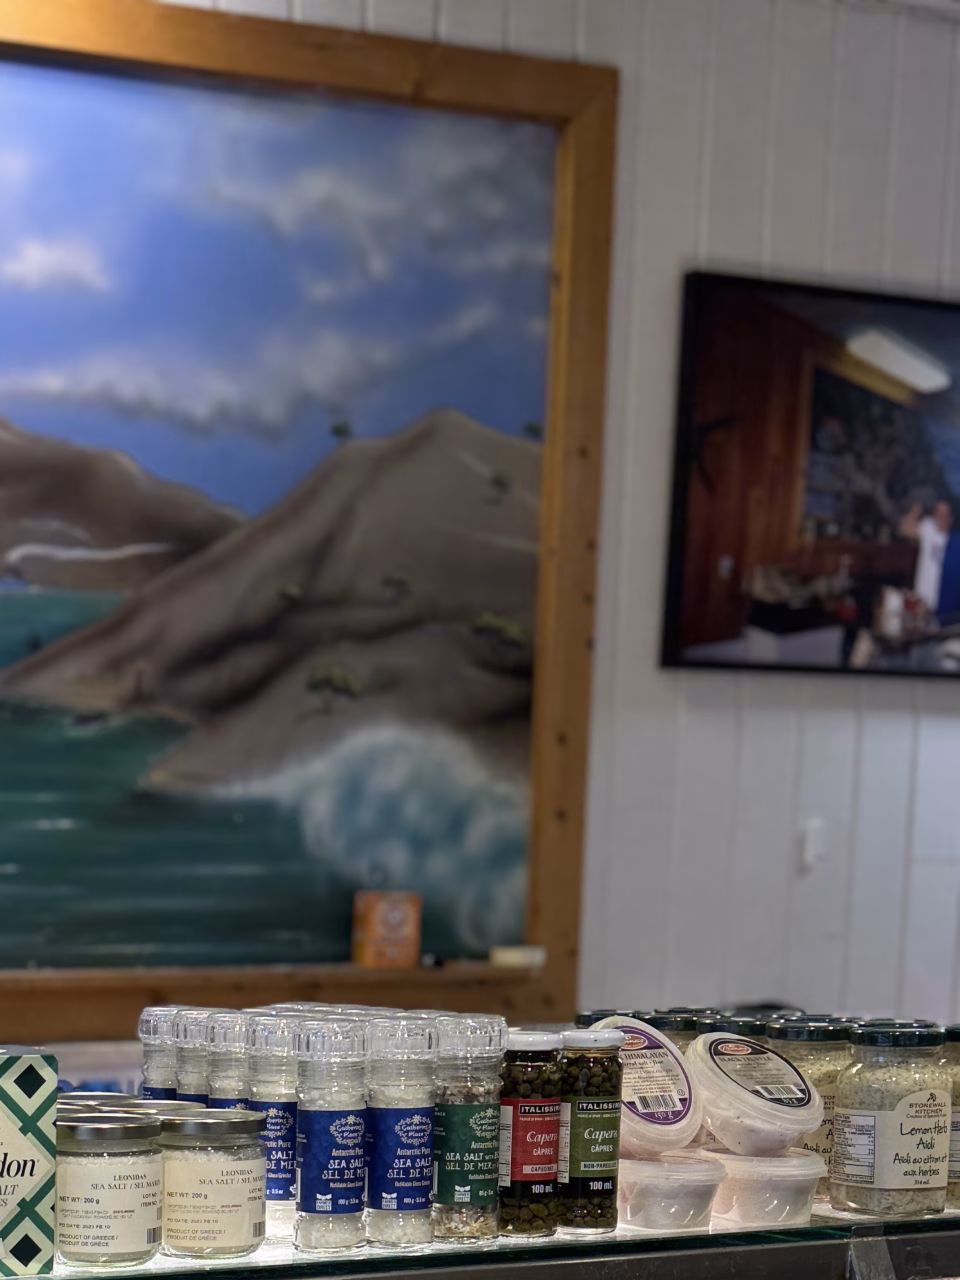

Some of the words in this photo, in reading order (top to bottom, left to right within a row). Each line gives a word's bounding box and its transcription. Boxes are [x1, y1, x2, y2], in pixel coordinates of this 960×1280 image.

[900, 1121, 932, 1136] Lemon
[532, 1146, 554, 1156] CÂPRES
[590, 1144, 614, 1153] CÂPRES
[270, 1150, 294, 1160] SALT
[445, 1152, 461, 1161] SEA
[463, 1152, 484, 1161] SALT
[265, 1160, 277, 1169] DE
[328, 1159, 347, 1169] SEA
[393, 1158, 412, 1169] SEA
[414, 1158, 432, 1168] SALT
[445, 1162, 461, 1171] SEL
[463, 1162, 475, 1171] DE
[477, 1162, 493, 1171] MER
[221, 1168, 253, 1177] LEONIDAS
[321, 1170, 341, 1180] SEL
[344, 1169, 355, 1179] DE
[387, 1169, 406, 1179] SEL
[409, 1168, 421, 1178] DE
[903, 1169, 917, 1177] aux
[918, 1165, 940, 1177] herbes
[113, 1173, 147, 1182] LEONIDAS
[215, 1178, 235, 1186] SALT
[90, 1183, 106, 1191] SEA
[107, 1182, 128, 1190] SALT
[531, 1184, 545, 1193] 100
[589, 1180, 603, 1190] 100
[59, 1195, 70, 1203] NET
